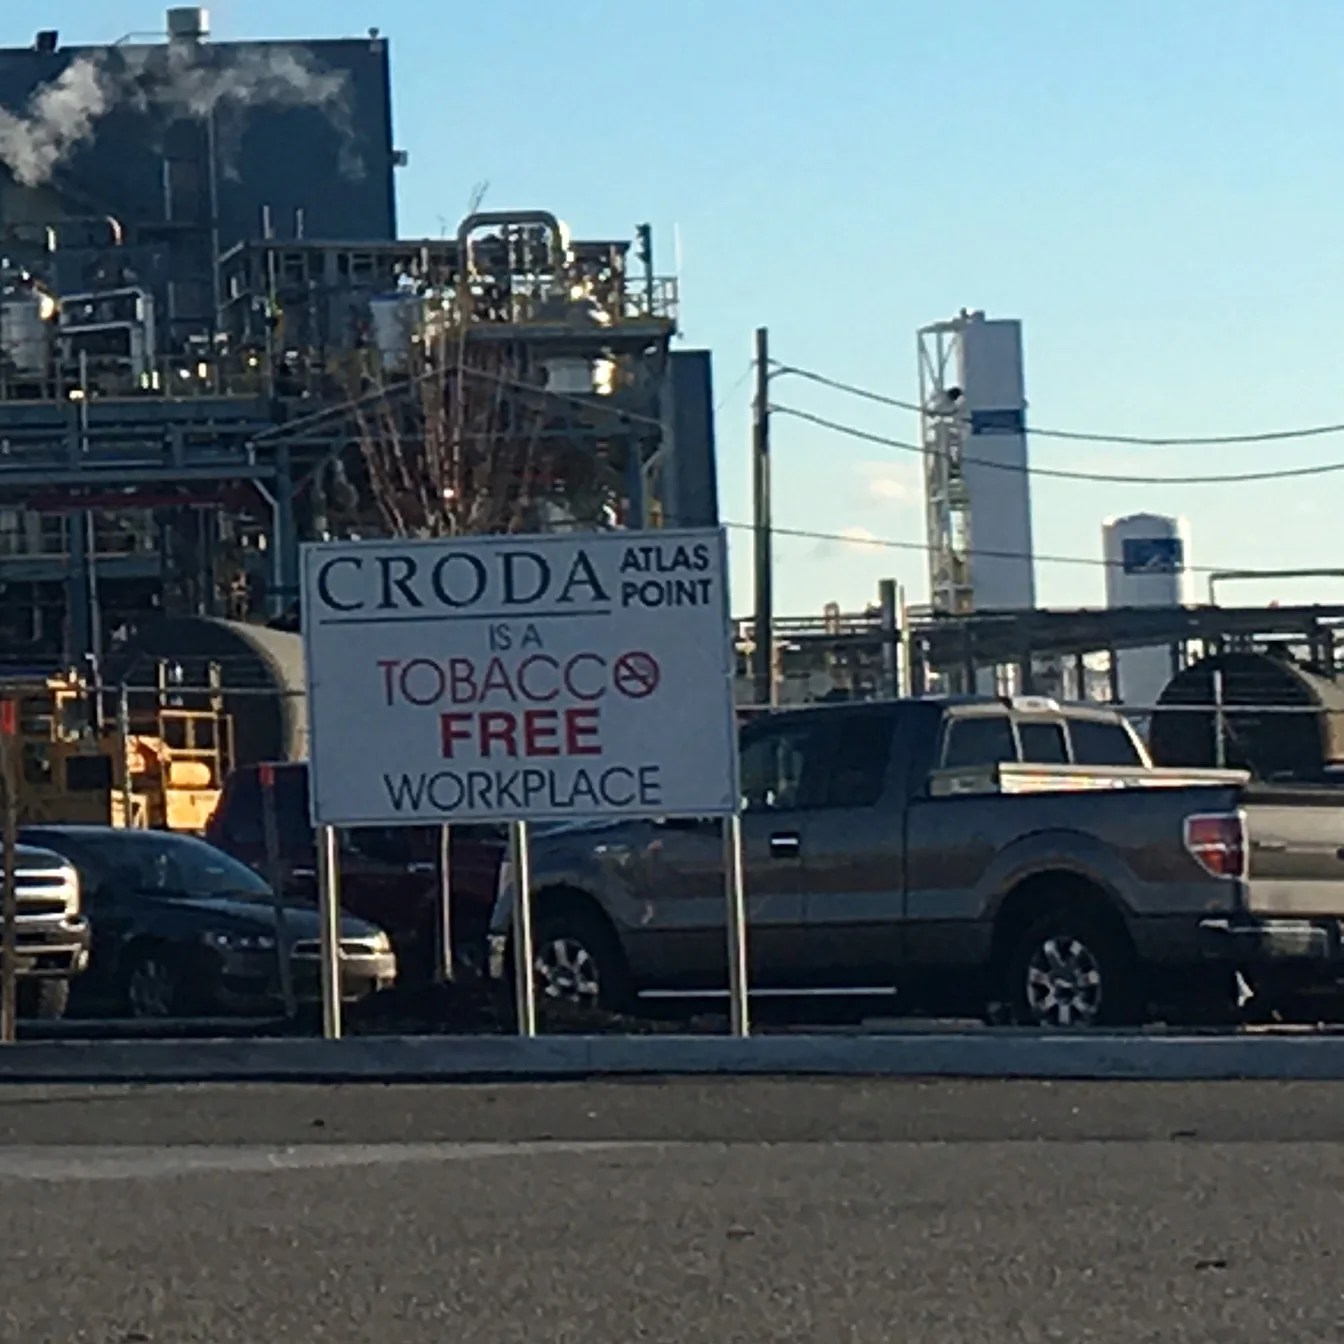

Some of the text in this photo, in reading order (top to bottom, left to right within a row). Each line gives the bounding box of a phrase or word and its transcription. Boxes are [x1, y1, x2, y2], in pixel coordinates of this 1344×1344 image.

[619, 544, 710, 574] ATLAS
[317, 550, 611, 613] CRODA
[621, 578, 712, 608] POINT
[489, 623, 544, 651] IS A
[440, 707, 604, 759] FREE
[383, 765, 663, 813] WORKPLACE
